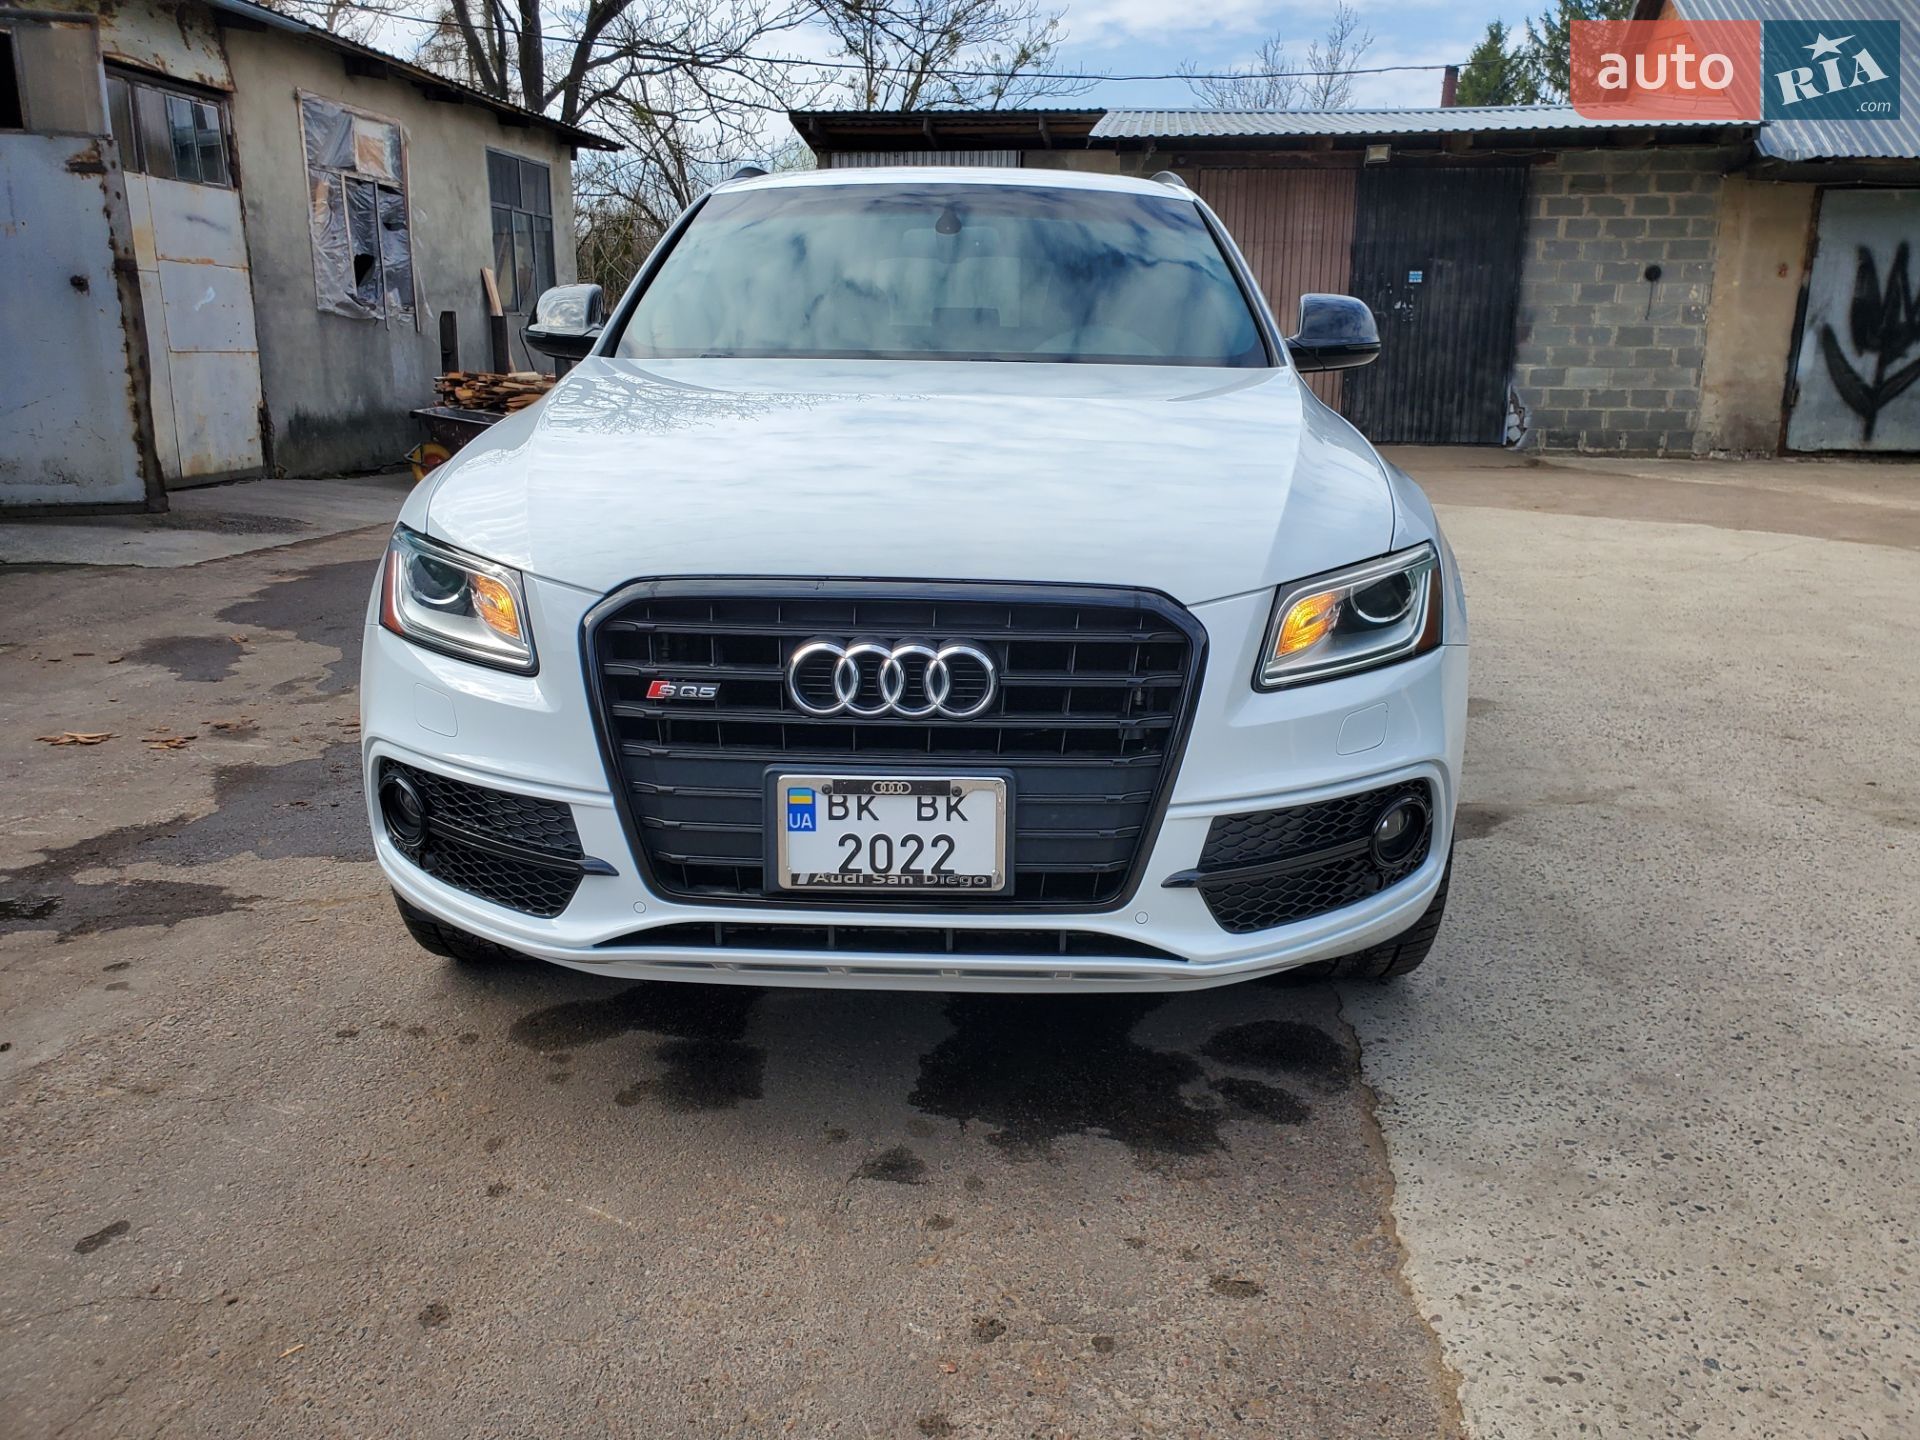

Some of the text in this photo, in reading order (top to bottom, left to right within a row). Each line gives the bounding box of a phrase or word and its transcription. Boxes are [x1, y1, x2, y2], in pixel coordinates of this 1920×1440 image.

[828, 795, 968, 822] BK BK
[788, 813, 813, 829] UA
[838, 833, 955, 874] 2022
[813, 873, 988, 887] Audi San Diego
